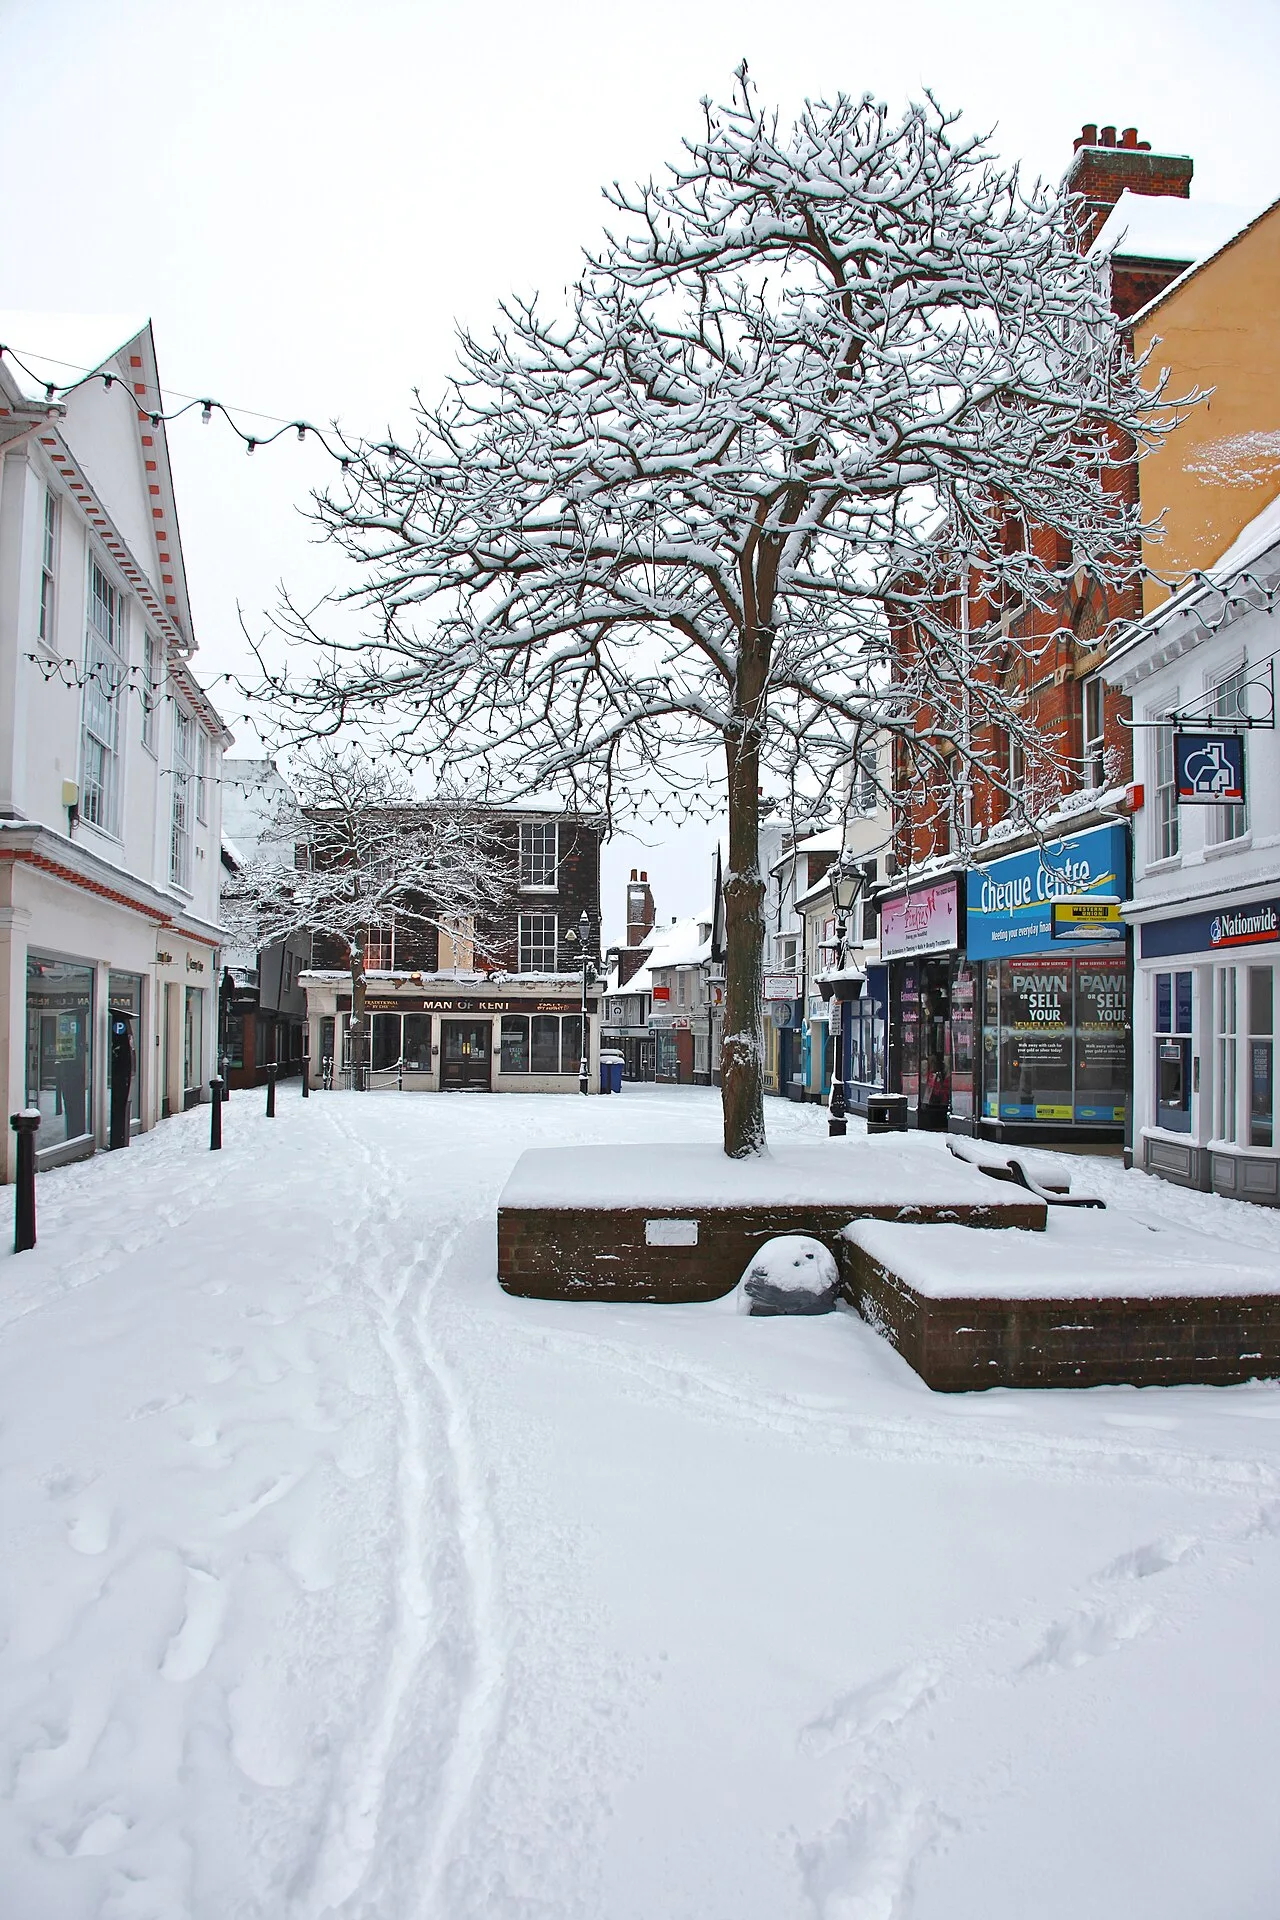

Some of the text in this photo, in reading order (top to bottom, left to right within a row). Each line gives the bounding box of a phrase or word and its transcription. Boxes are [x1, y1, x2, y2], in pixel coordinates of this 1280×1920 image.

[981, 858, 1090, 918] Cheque Centre
[1221, 907, 1277, 937] Nationwide
[992, 929, 1008, 941] Meeting
[1008, 929, 1018, 941] your
[1019, 923, 1038, 937] everyday
[1012, 976, 1067, 992] PAWN
[1029, 994, 1061, 1008] SELL
[1029, 1010, 1061, 1020] YOUR
[116, 1023, 124, 1034] P
[1014, 1022, 1066, 1030] JEWELLERY
